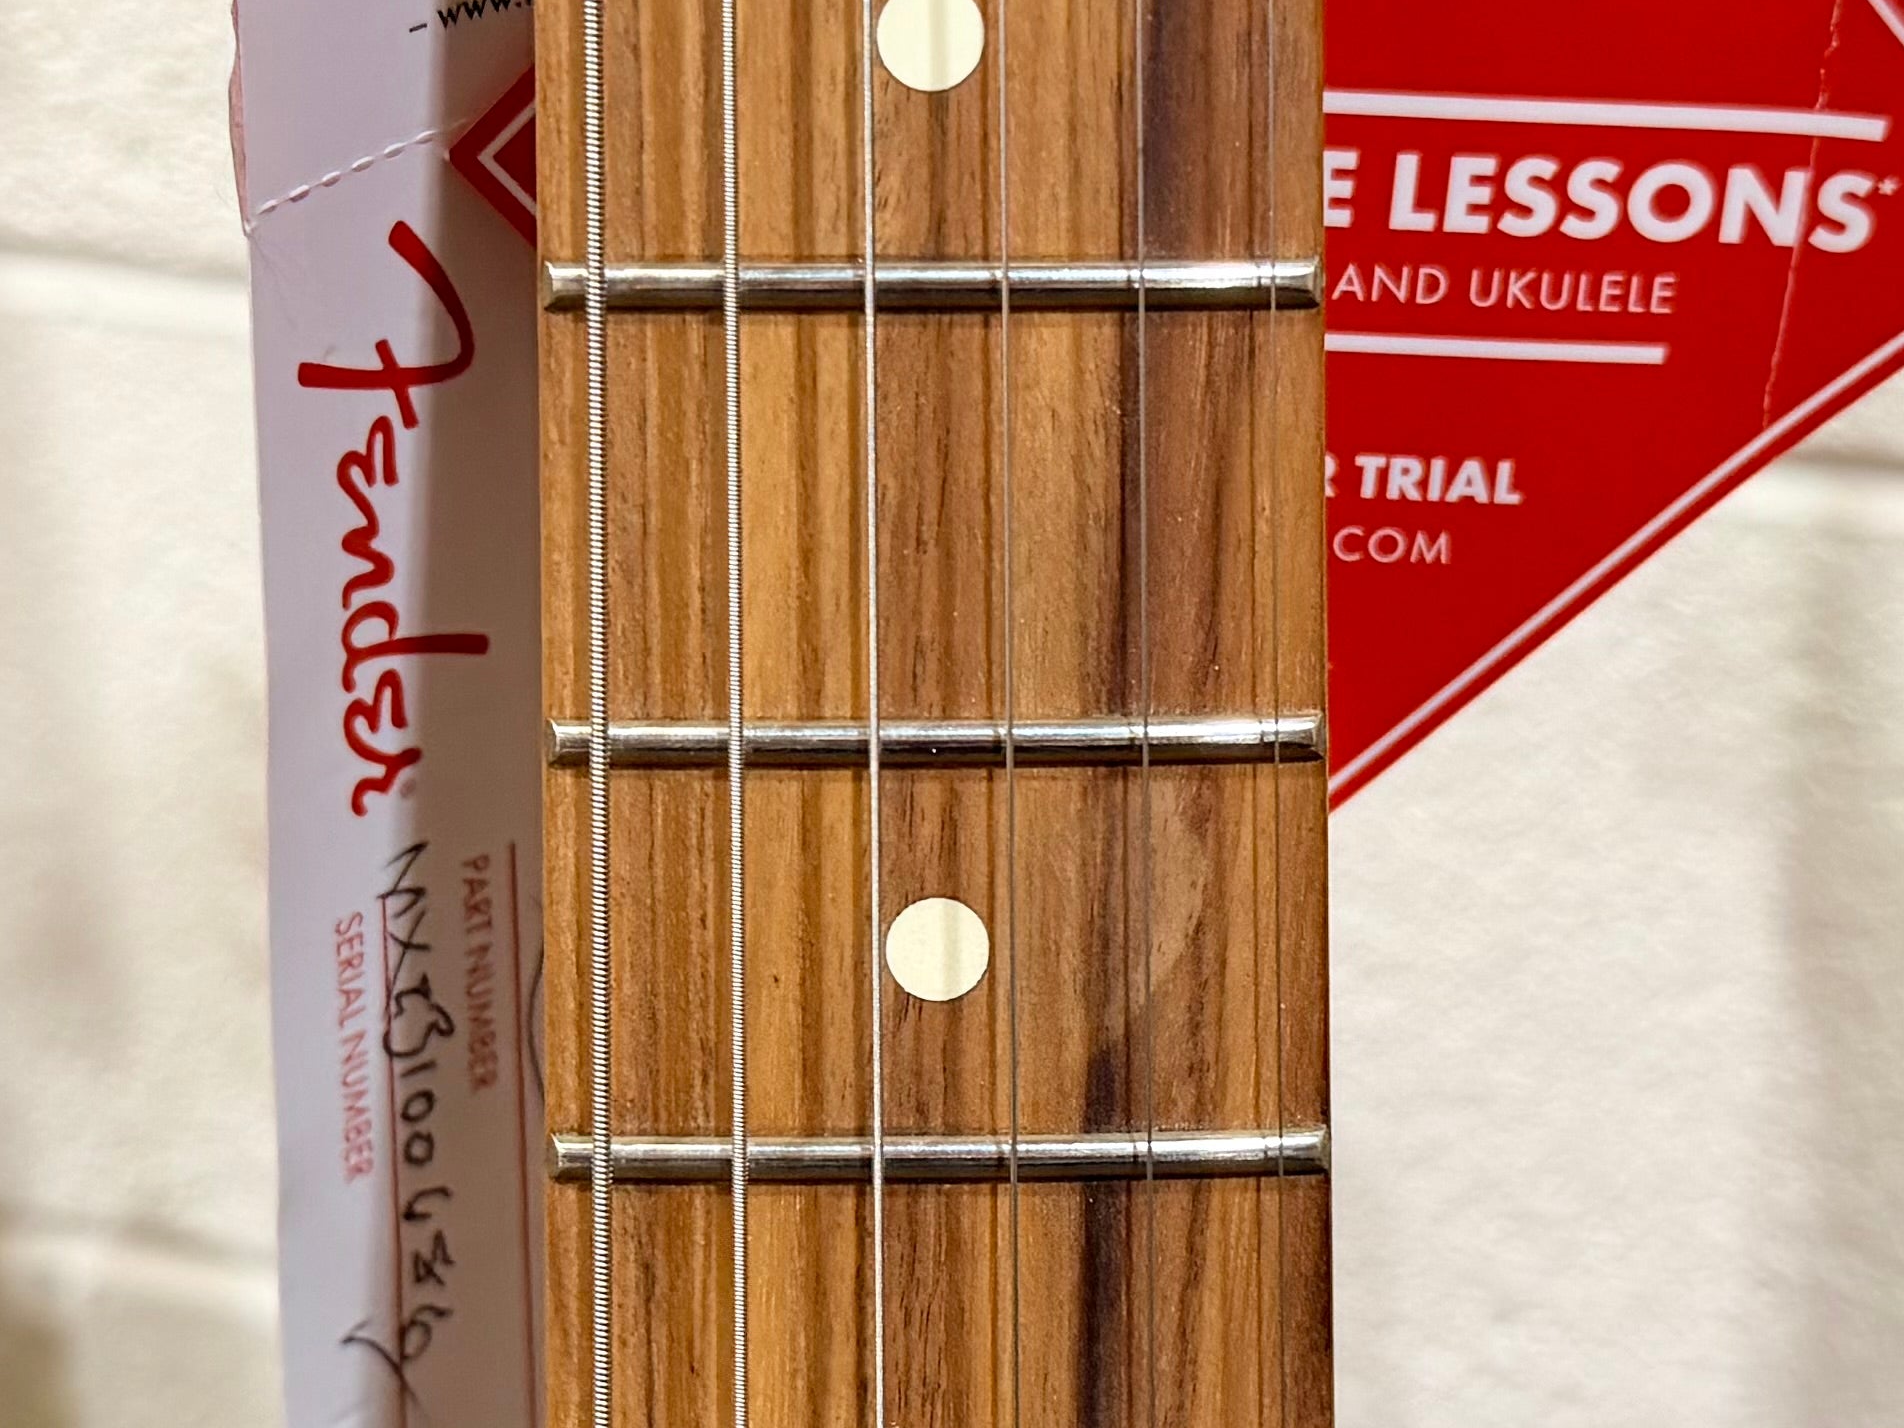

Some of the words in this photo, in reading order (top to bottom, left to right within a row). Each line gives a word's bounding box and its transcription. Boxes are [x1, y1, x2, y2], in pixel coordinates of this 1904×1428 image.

[1331, 262, 1449, 305] AND
[1467, 267, 1679, 315] UKULELE
[296, 219, 489, 818] Fender
[1354, 452, 1523, 506] TRIAL
[460, 853, 494, 937] PART
[332, 912, 368, 1030] SERIAL
[463, 943, 500, 1093] NUMBER
[338, 1033, 376, 1184] NUMBER
